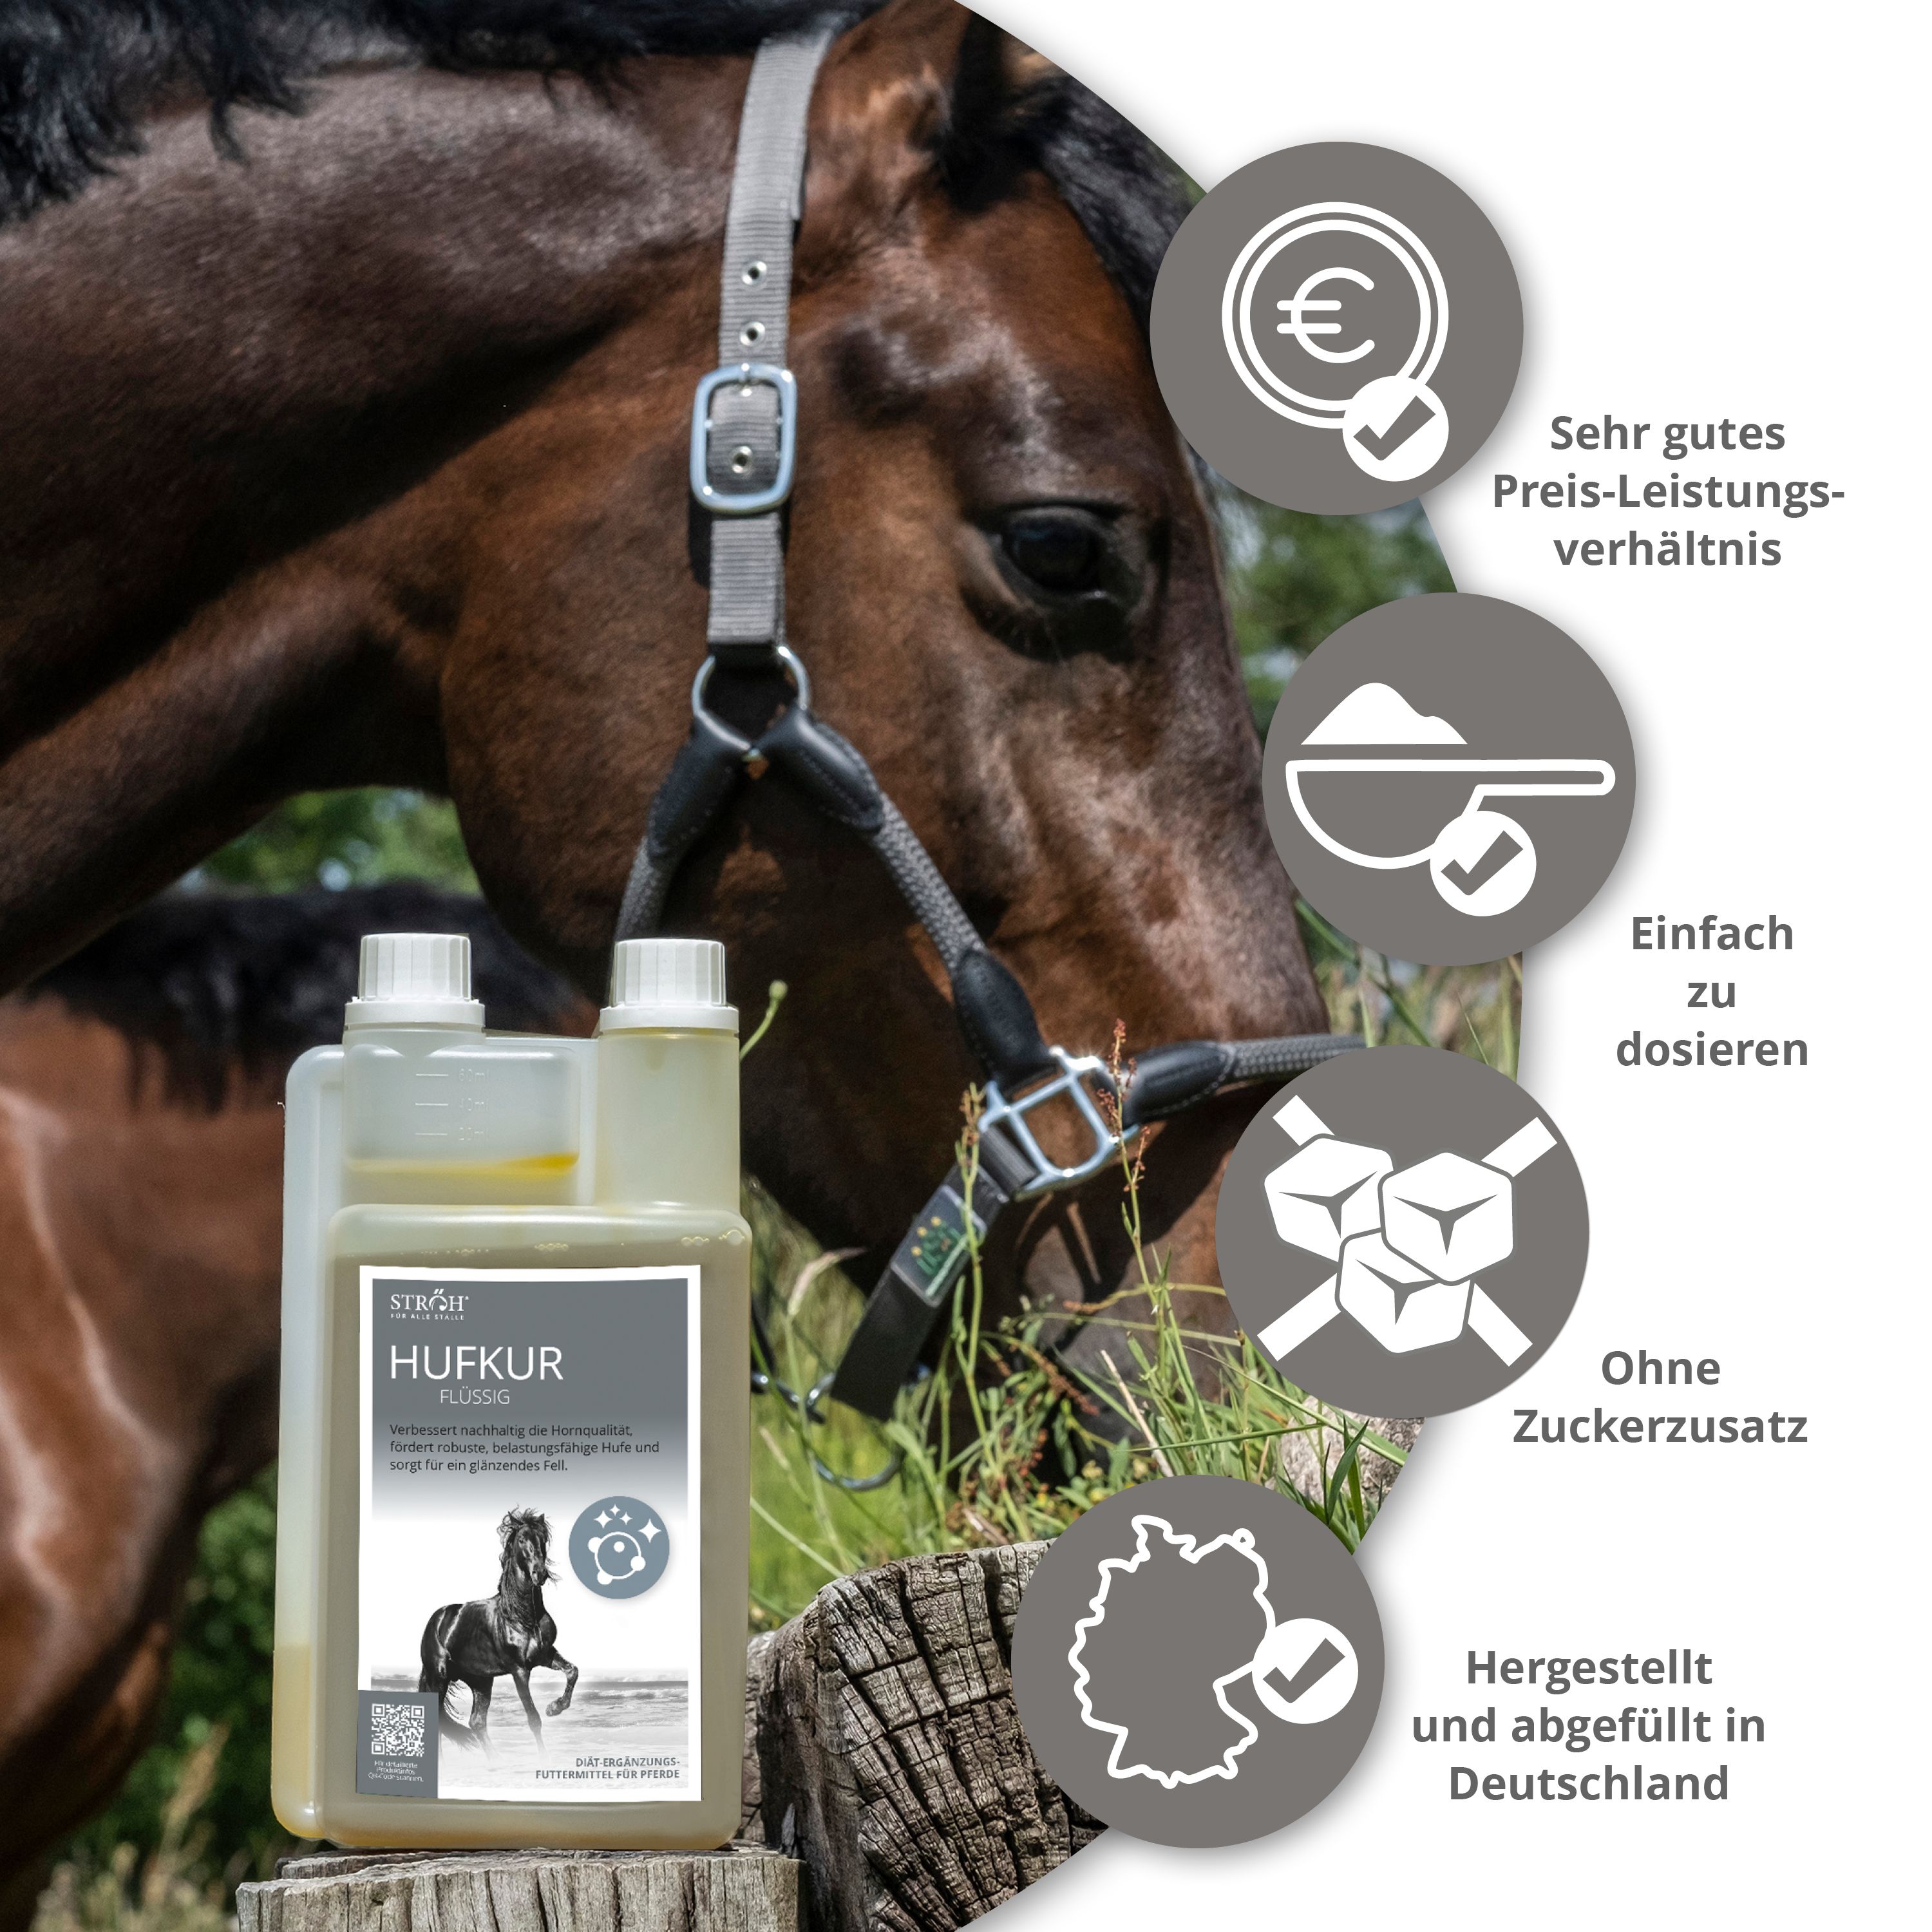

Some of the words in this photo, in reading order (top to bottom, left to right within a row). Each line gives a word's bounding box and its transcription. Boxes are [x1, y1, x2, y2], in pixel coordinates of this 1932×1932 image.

[391, 1345, 564, 1381] HUFKUR
[440, 1385, 510, 1405] FLÜSSIG
[390, 1423, 457, 1435] Verbessert
[461, 1424, 525, 1439] nachhaltig
[529, 1425, 547, 1436] die
[551, 1424, 633, 1438] Hornqualität,
[390, 1441, 434, 1453] fördert
[437, 1441, 489, 1455] robuste,
[493, 1441, 598, 1456] belastungsfähige
[601, 1441, 632, 1453] Hufe
[635, 1441, 659, 1453] und
[390, 1460, 422, 1473] sorgt
[426, 1459, 444, 1471] für
[447, 1459, 466, 1471] ein
[469, 1459, 540, 1474] glänzendes
[544, 1459, 568, 1471] Fell.
[576, 1756, 680, 1768] DIÄT-ERGÄNZUNGS-
[536, 1770, 614, 1779] FUTTERMITTEL
[616, 1768, 638, 1779] FÜR
[640, 1769, 679, 1779] PFERDE
